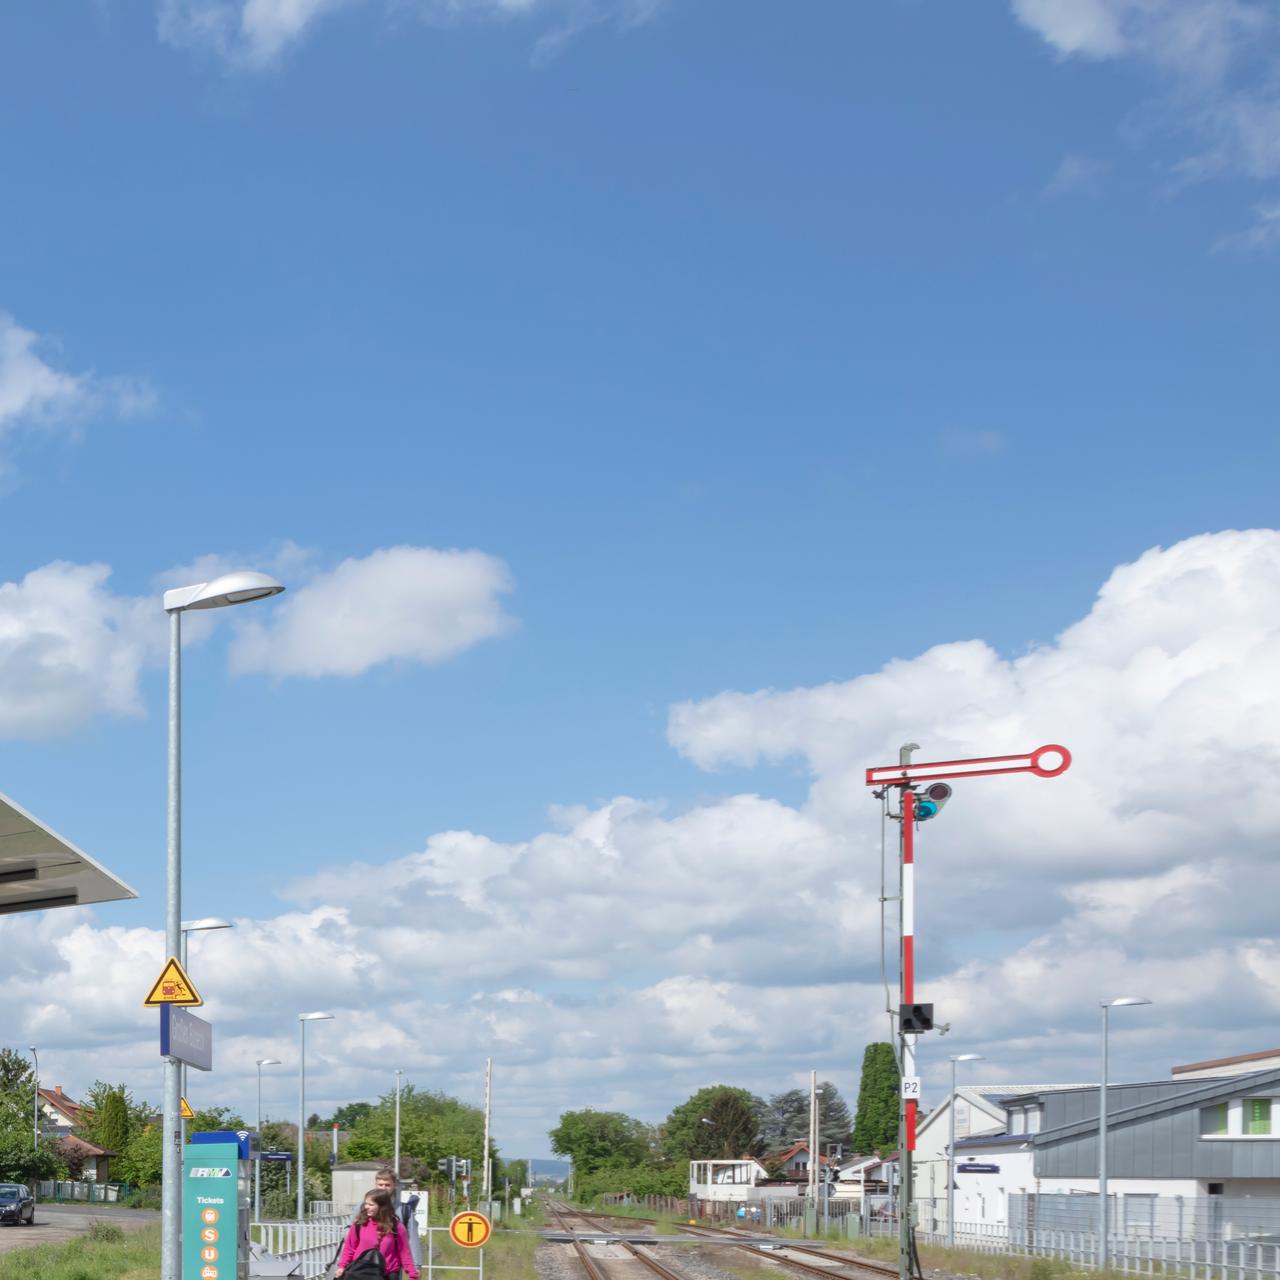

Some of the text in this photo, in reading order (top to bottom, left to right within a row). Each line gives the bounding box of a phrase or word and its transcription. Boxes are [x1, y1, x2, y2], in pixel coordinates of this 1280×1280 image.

[904, 1082, 918, 1093] P2
[194, 1167, 230, 1177] RMV
[197, 1196, 224, 1204] Tickets
[205, 1229, 215, 1240] S
